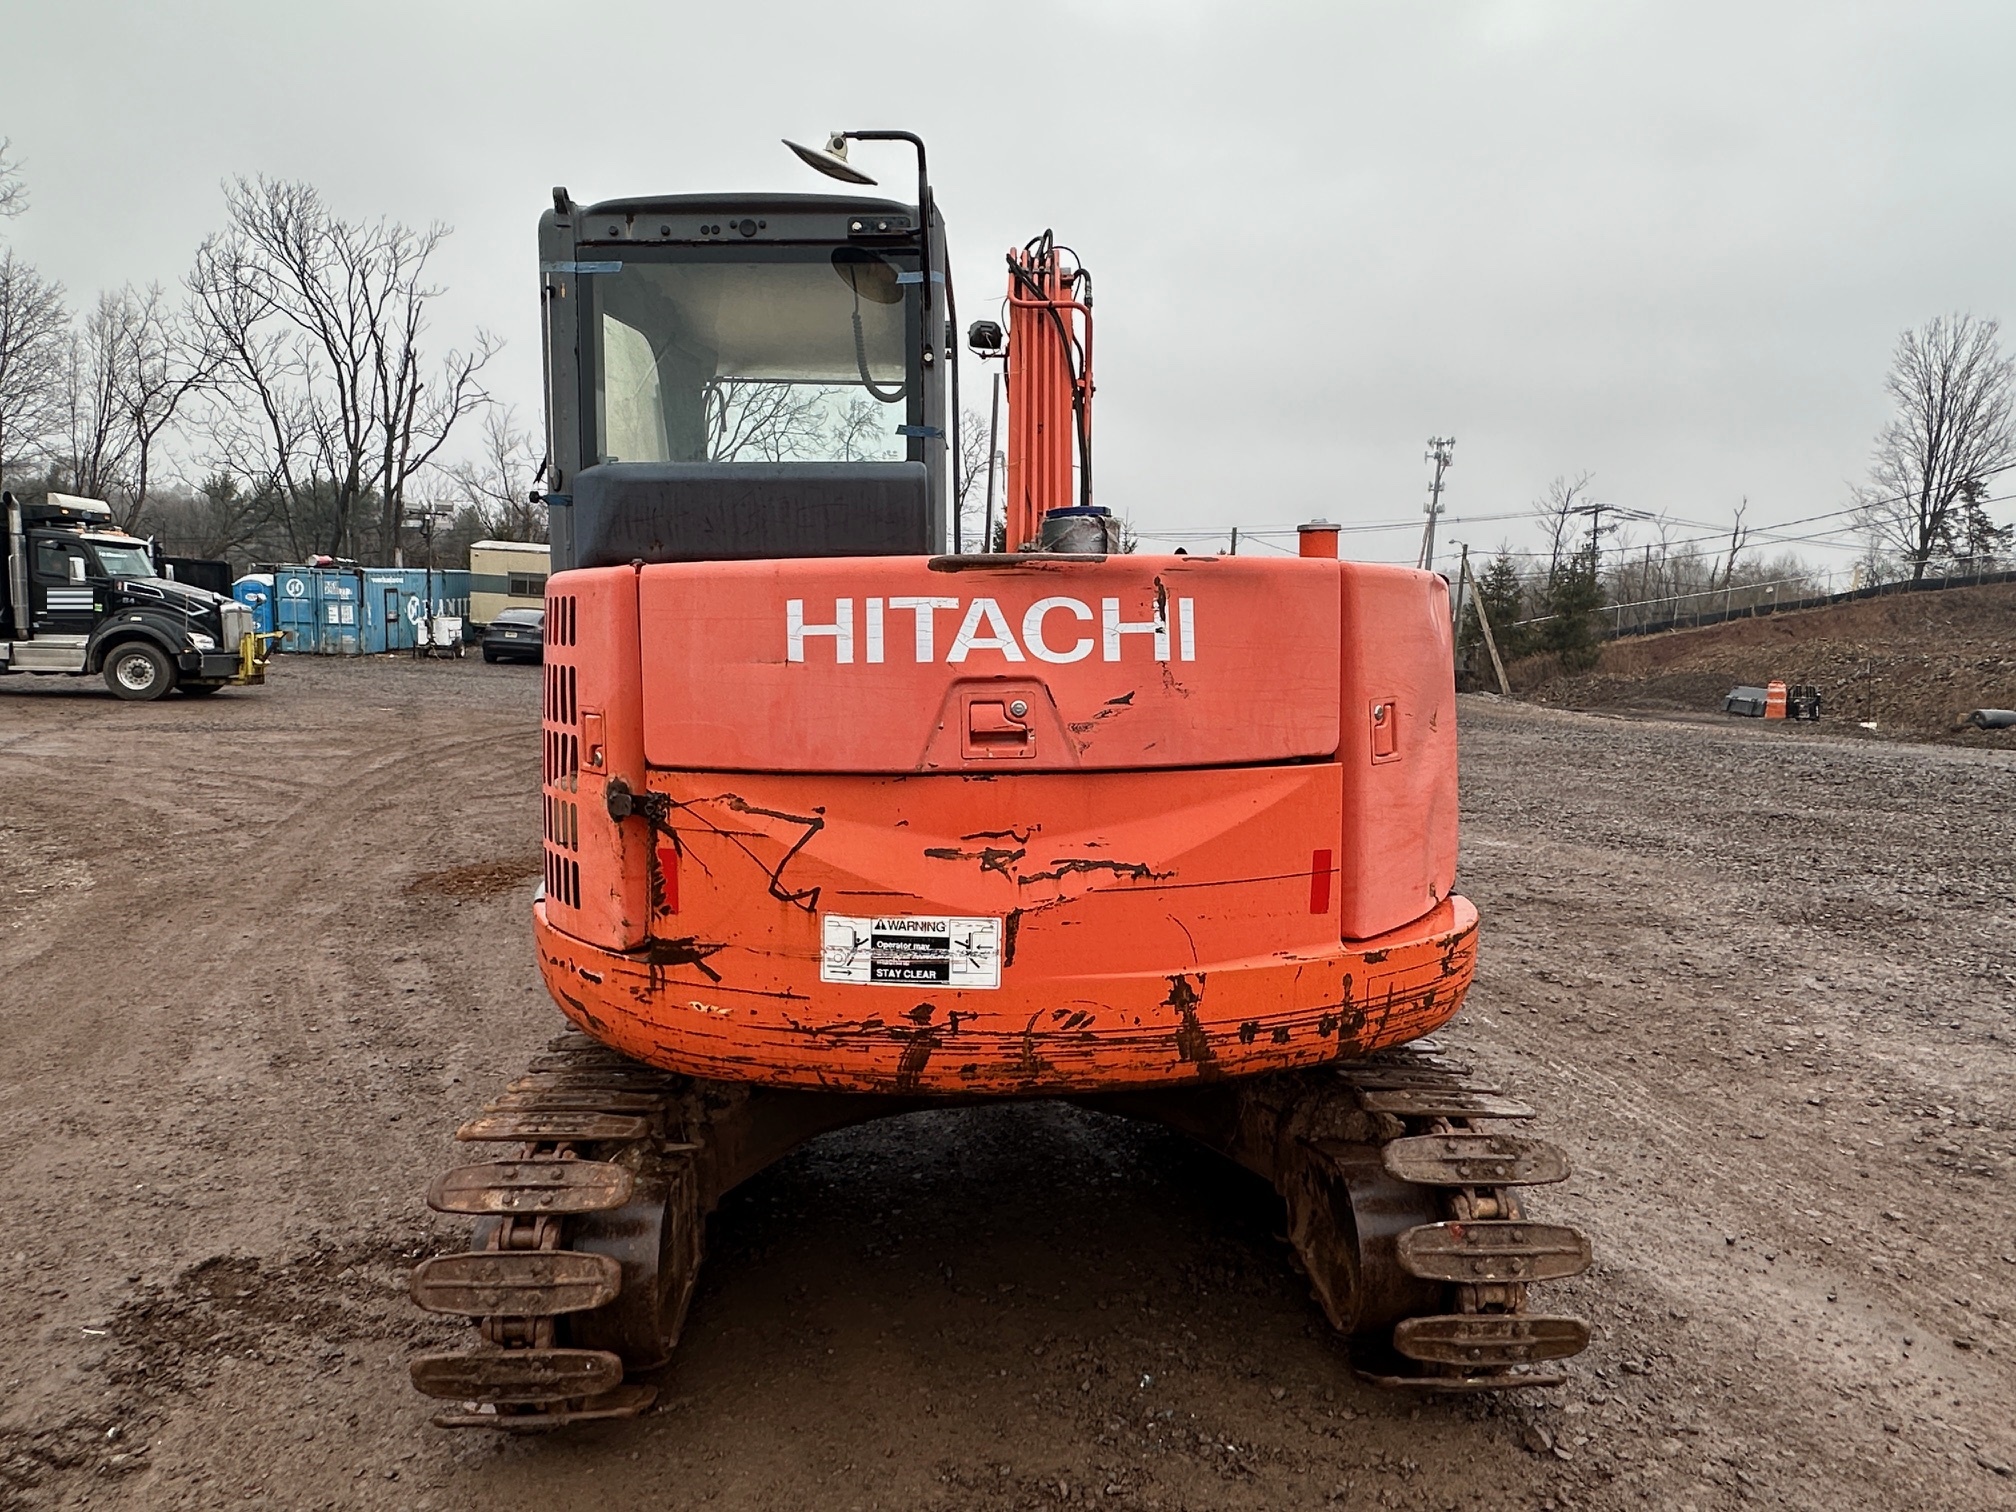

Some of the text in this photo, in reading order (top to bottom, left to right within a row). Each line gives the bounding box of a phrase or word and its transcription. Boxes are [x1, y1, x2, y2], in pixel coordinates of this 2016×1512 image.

[786, 596, 1195, 664] HITACHI
[887, 920, 946, 932] WARNING
[876, 940, 931, 952] Operator may
[876, 968, 936, 979] STAY CLEAR
